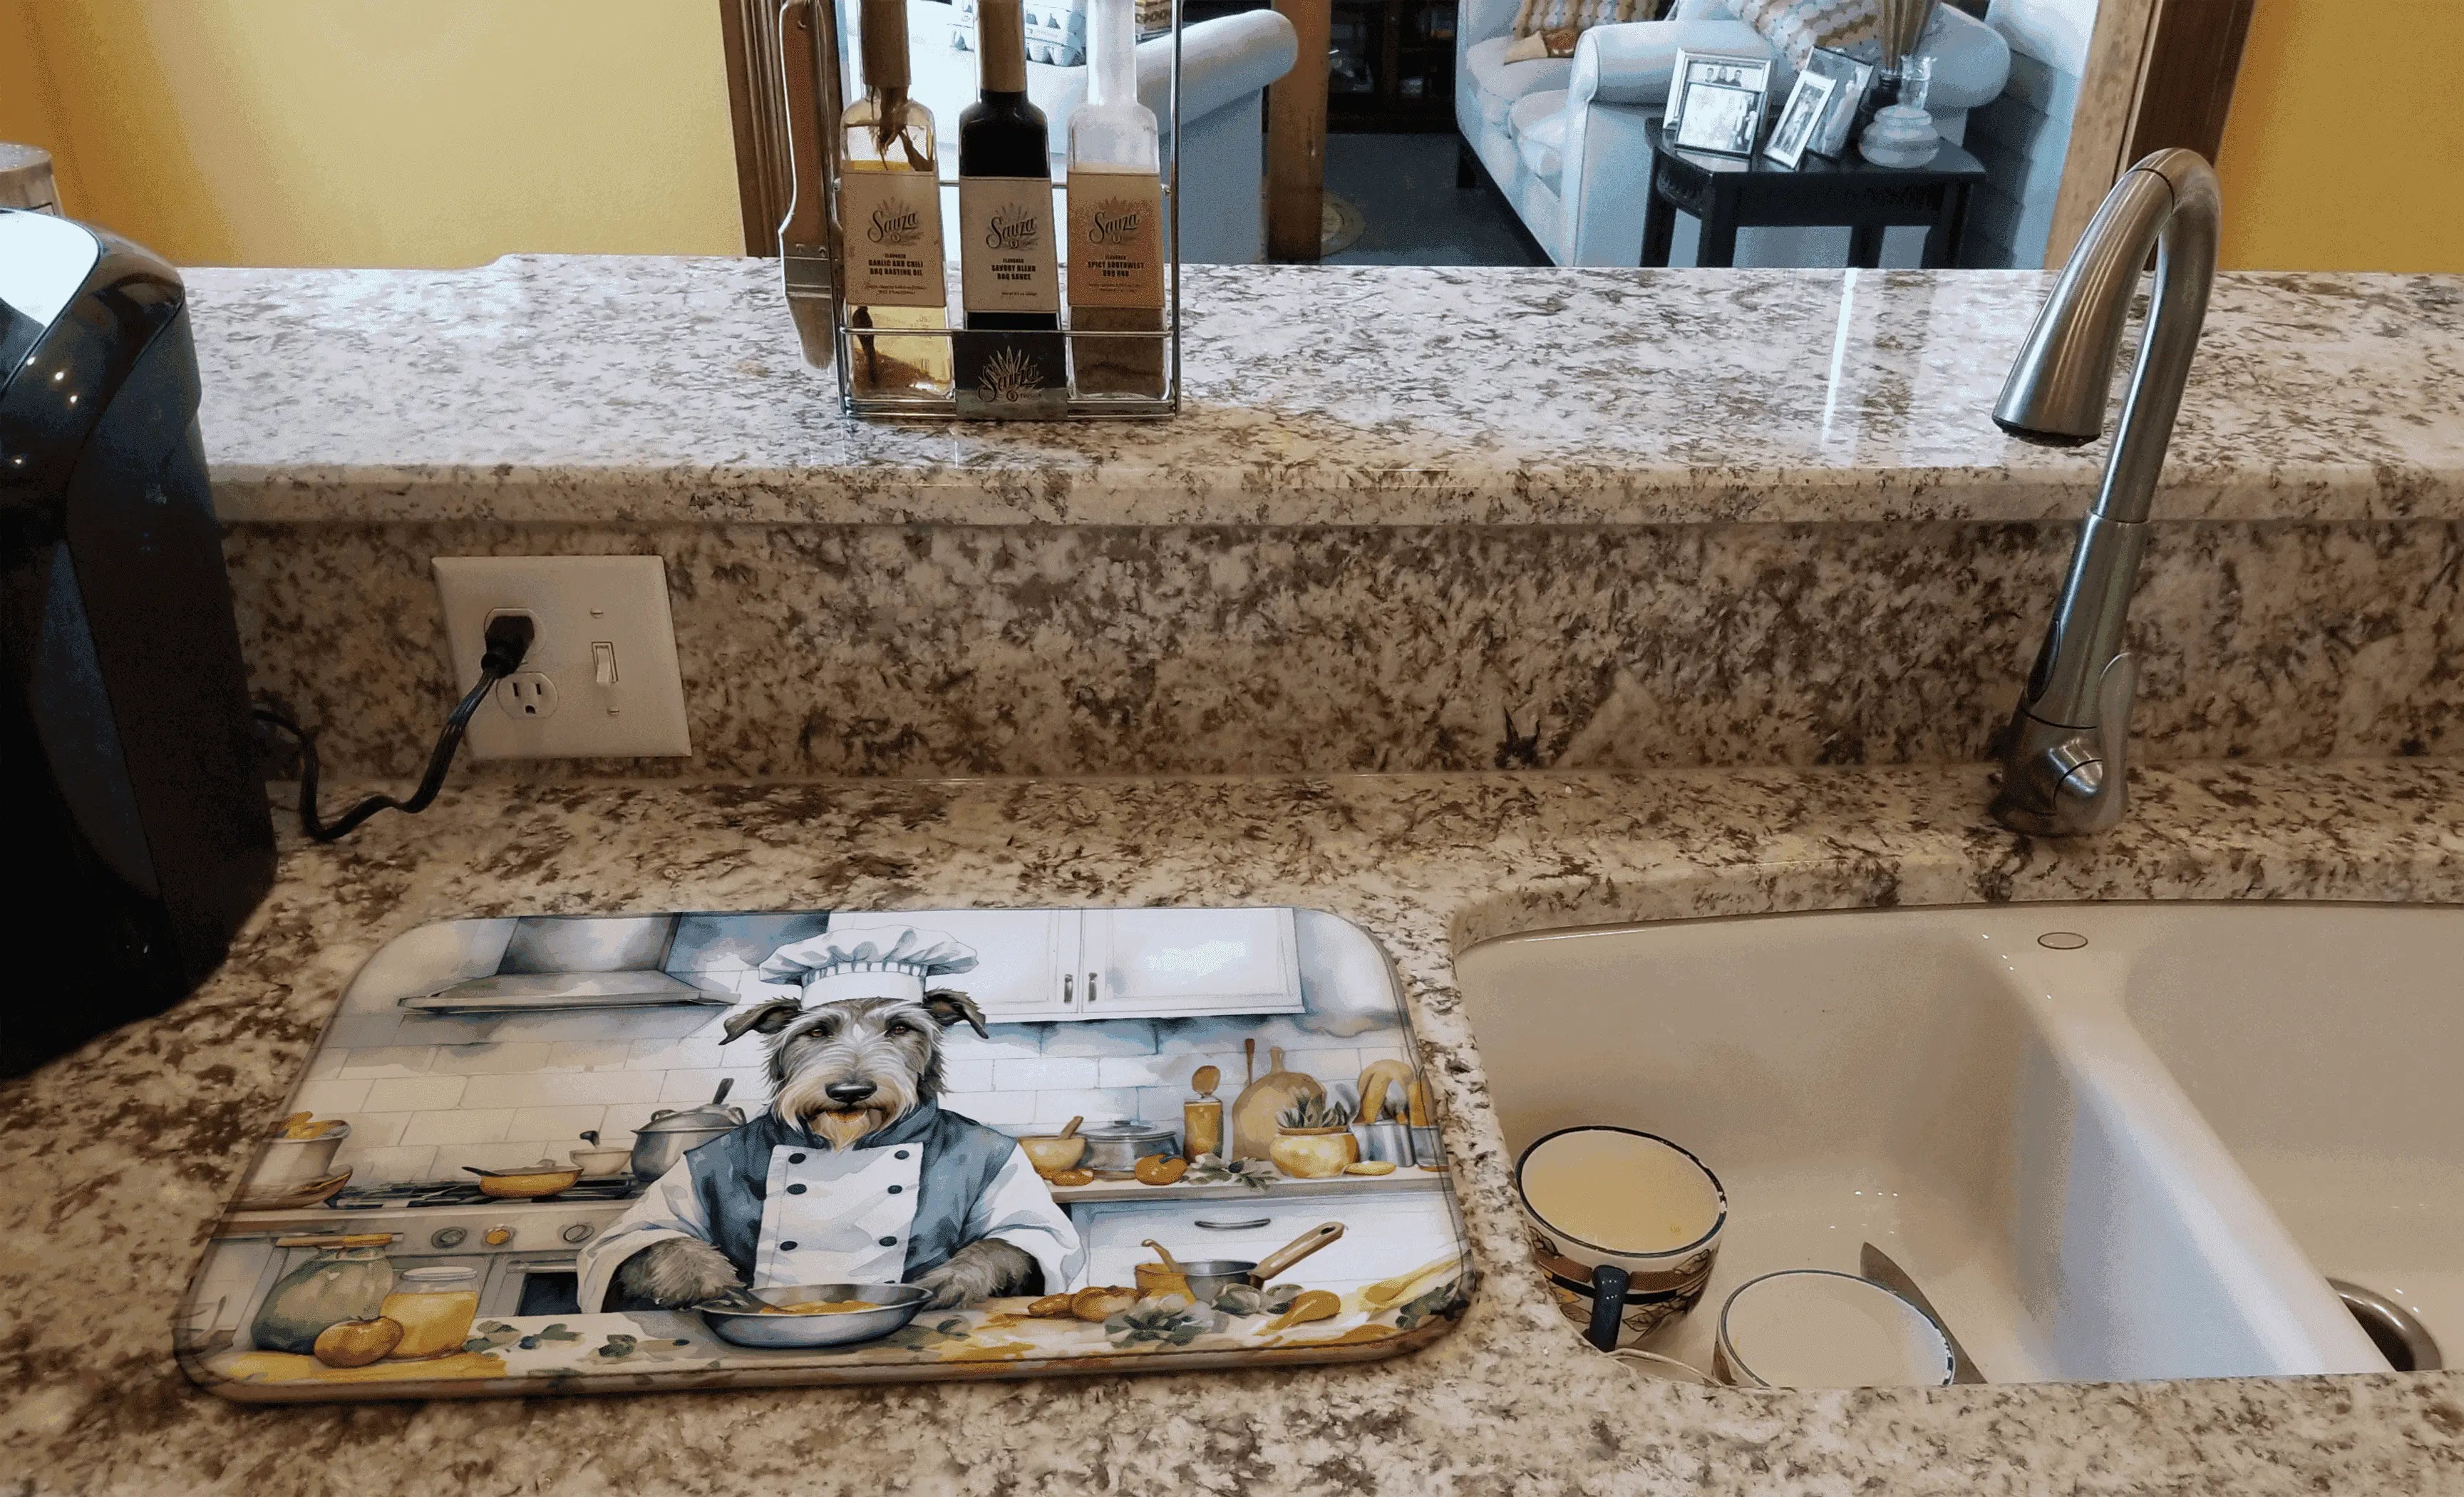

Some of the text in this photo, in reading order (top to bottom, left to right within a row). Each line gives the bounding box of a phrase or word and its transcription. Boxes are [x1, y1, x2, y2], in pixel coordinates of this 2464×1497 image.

[867, 210, 918, 242] Sauza
[986, 217, 1037, 248] Sauza
[1089, 211, 1138, 243] Sauza
[978, 364, 1040, 402] Sauza
